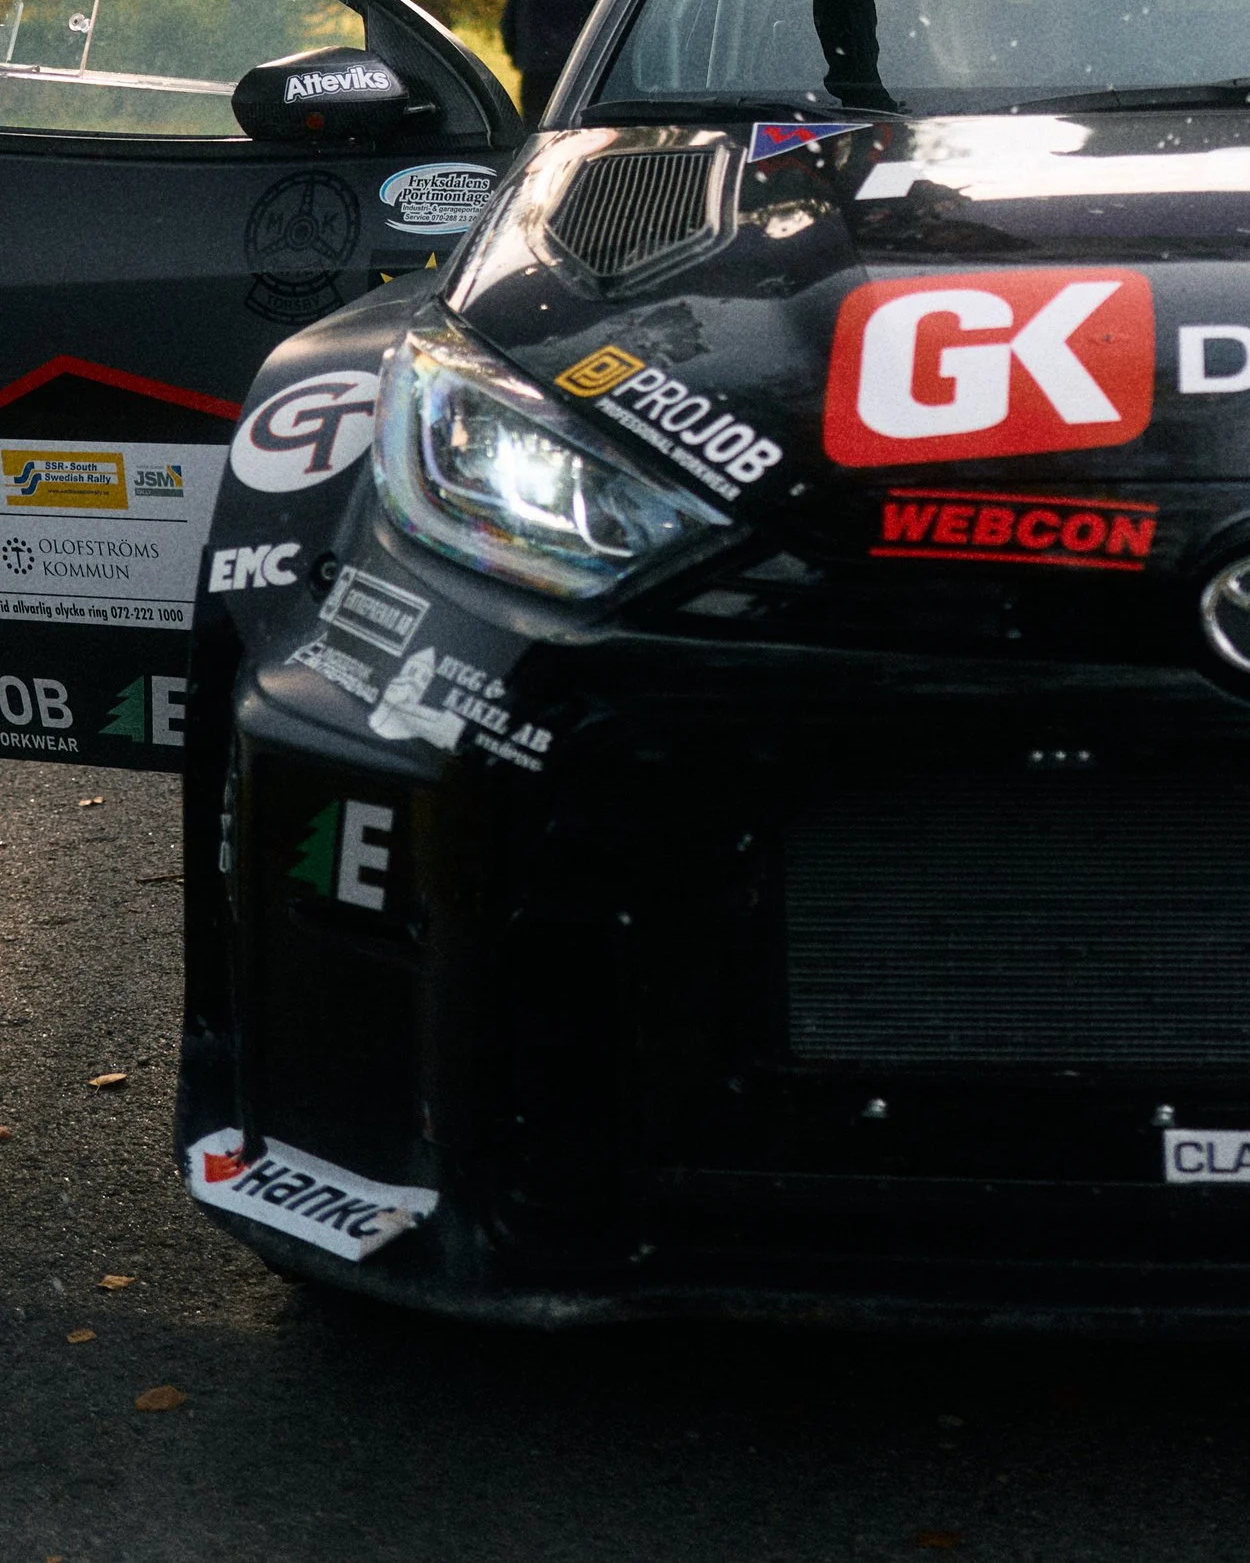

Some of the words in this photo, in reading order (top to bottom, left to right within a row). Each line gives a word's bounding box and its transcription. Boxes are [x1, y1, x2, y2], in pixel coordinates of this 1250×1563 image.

[286, 67, 390, 102] Atteviks
[407, 174, 489, 190] Fryksdalens
[401, 188, 490, 206] Portmontage
[405, 213, 430, 221] Service
[857, 280, 1124, 440] GK
[612, 367, 783, 484] PROJOB
[70, 462, 98, 471] South
[44, 473, 84, 483] Swedish
[87, 474, 111, 485] Rally
[133, 470, 175, 487] JSM
[881, 501, 1159, 557] WEBCON
[38, 539, 160, 559] OLOFSTRÖMS
[43, 561, 130, 580] KOMMUN
[208, 542, 301, 593] EMC
[0, 601, 10, 613] id
[13, 601, 52, 618] allvarlig
[55, 604, 86, 619] olycka
[88, 606, 109, 621] ring
[110, 607, 155, 620] 072-222
[158, 609, 184, 622] 1000
[0, 731, 79, 753] ORKWEAR
[337, 798, 395, 911] E
